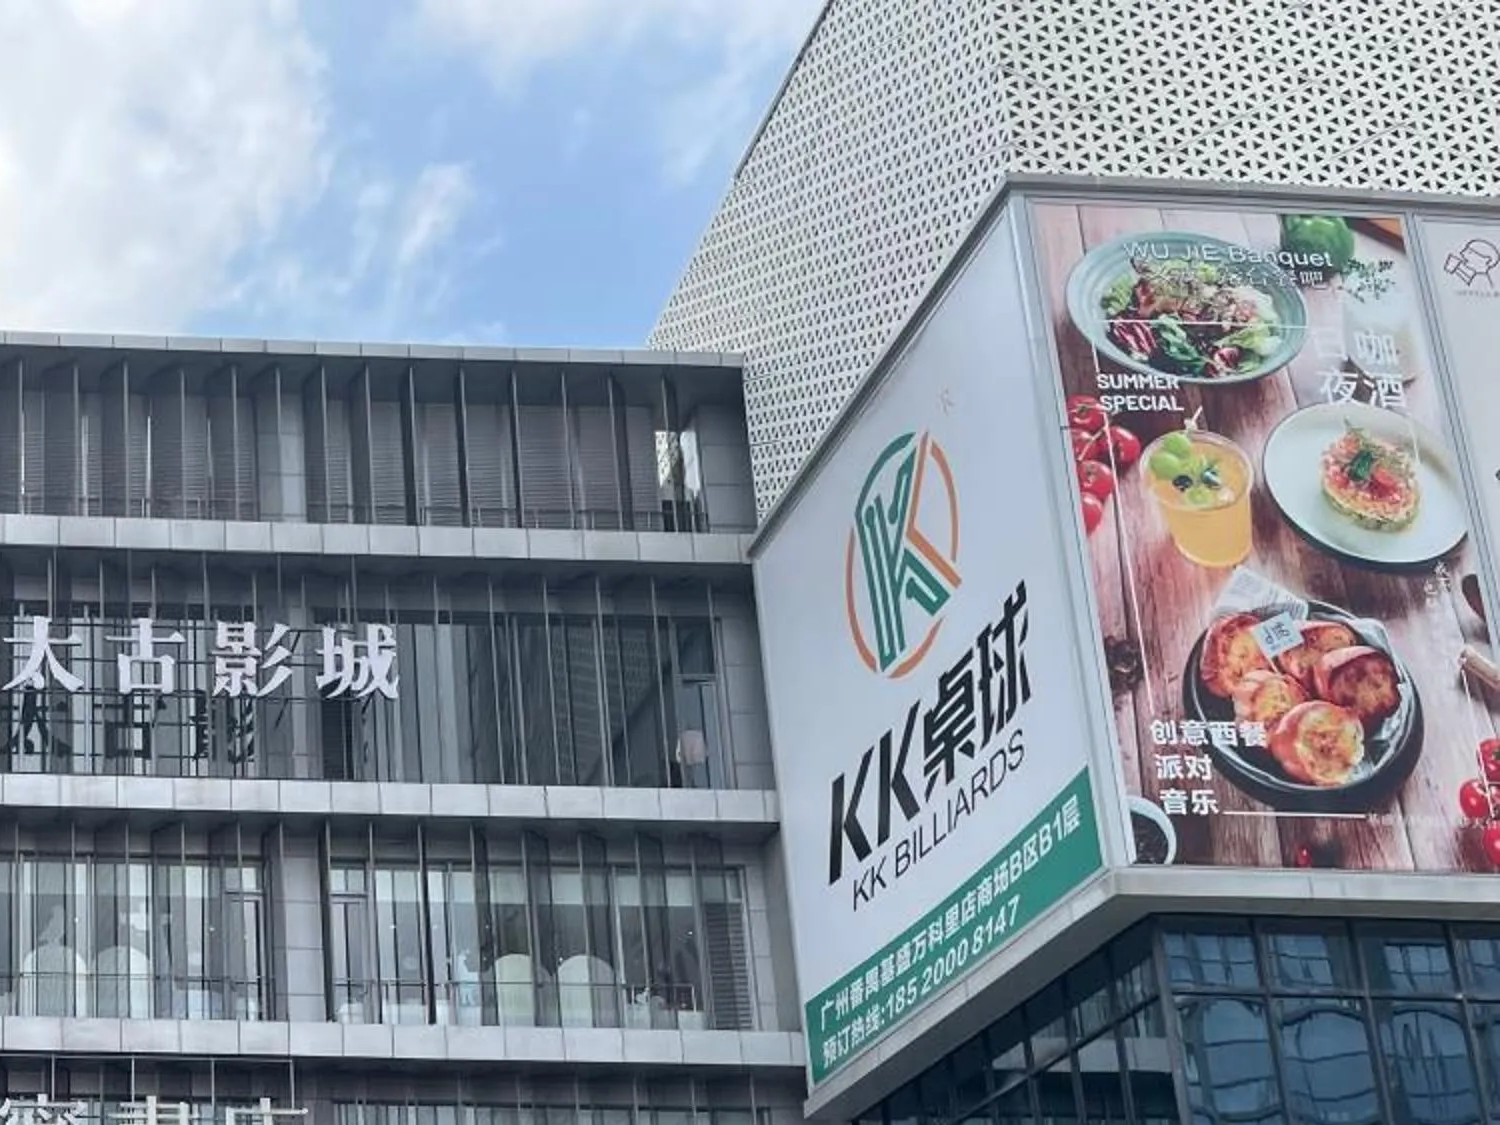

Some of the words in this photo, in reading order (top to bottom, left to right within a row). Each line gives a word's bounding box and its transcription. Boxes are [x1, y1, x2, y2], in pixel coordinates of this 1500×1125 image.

[1229, 246, 1333, 268] Banquet
[1096, 373, 1179, 390] SUMMER
[1099, 394, 1185, 412] SPECIAL
[1150, 719, 1268, 748] 创意西餐
[1154, 753, 1212, 780] 派对
[1160, 788, 1219, 815] 音乐
[852, 856, 887, 912] KK
[895, 728, 1025, 878] BILLIARDS
[921, 943, 968, 996] 2000
[971, 893, 1021, 956] 8147
